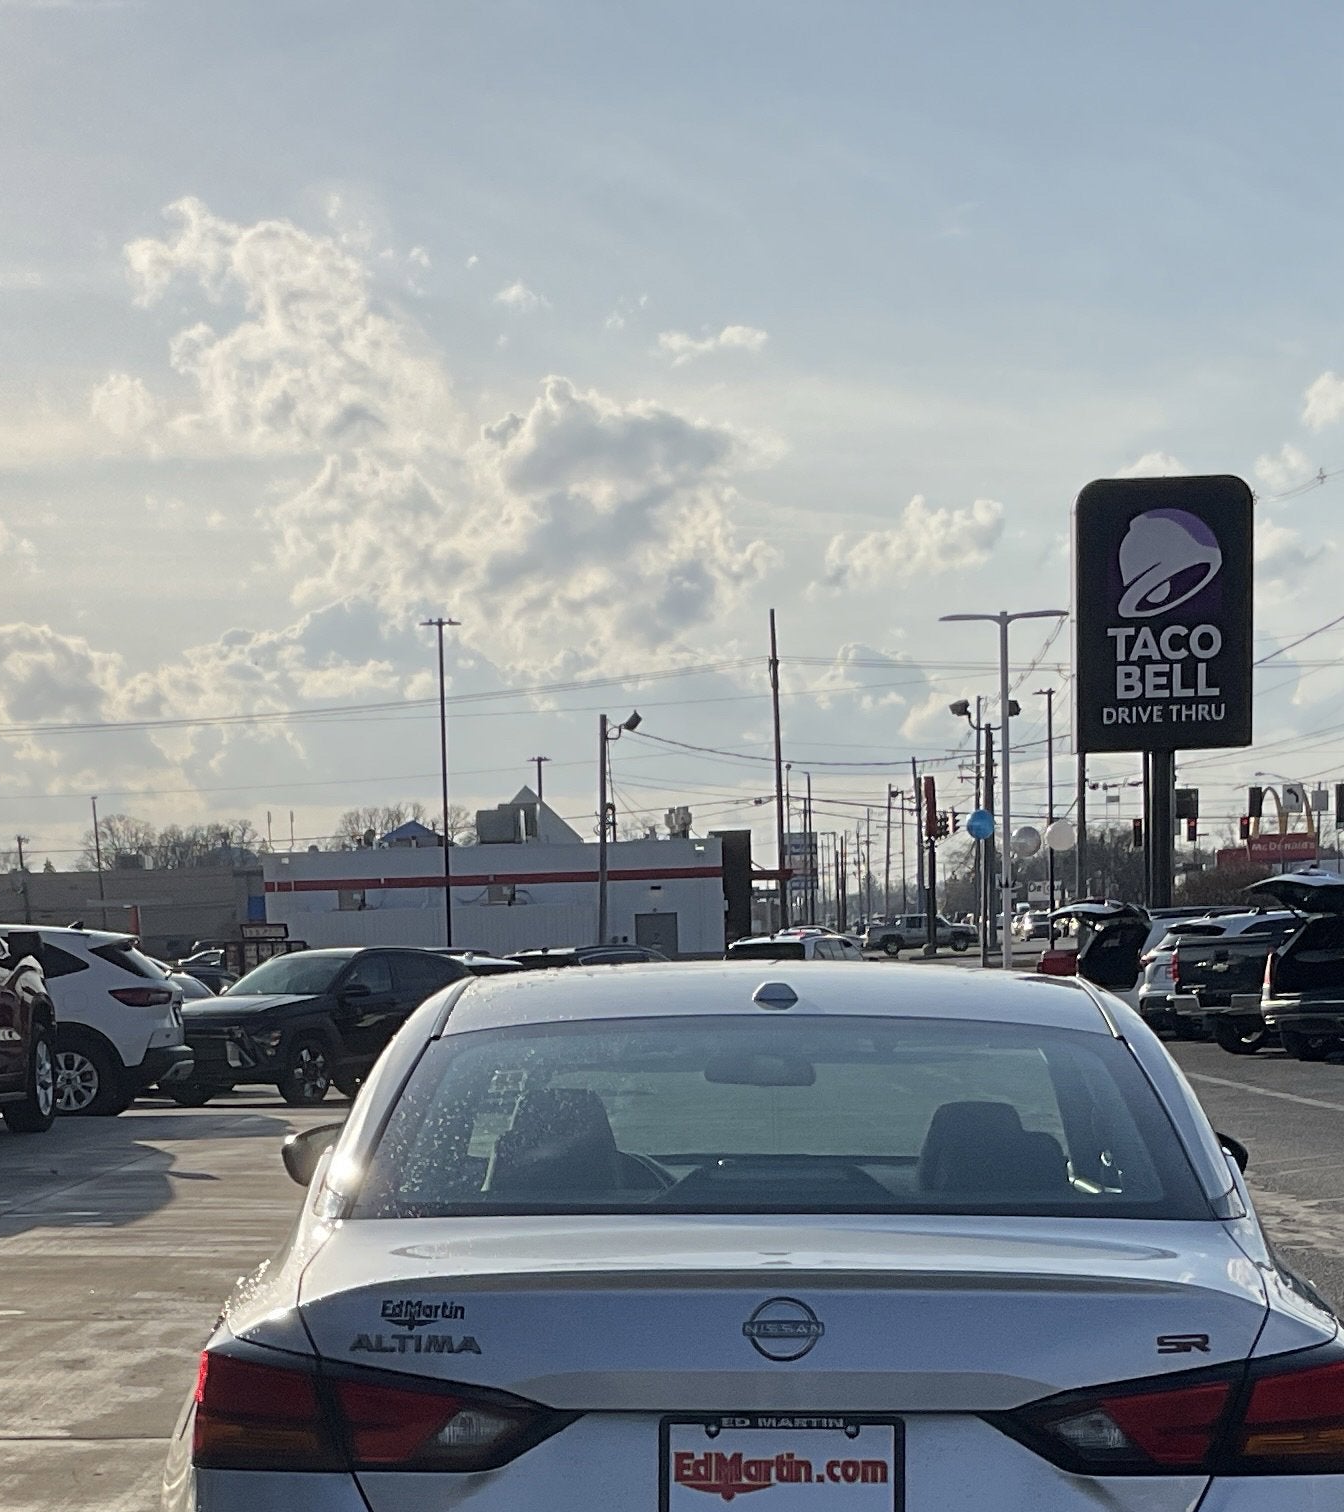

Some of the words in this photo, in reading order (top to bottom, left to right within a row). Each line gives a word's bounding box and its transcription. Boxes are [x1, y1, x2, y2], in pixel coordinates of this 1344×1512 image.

[1107, 624, 1222, 662] TACO
[1116, 662, 1220, 700] BELL
[1102, 705, 1163, 725] DRIVE
[1169, 703, 1226, 722] THRU
[744, 1322, 823, 1334] NISSAN
[349, 1334, 482, 1354] ALTIMA
[1157, 1333, 1211, 1354] SR
[720, 1417, 751, 1427] ED
[757, 1417, 844, 1428] MARTIN
[674, 1452, 888, 1492] EdMartin.com
